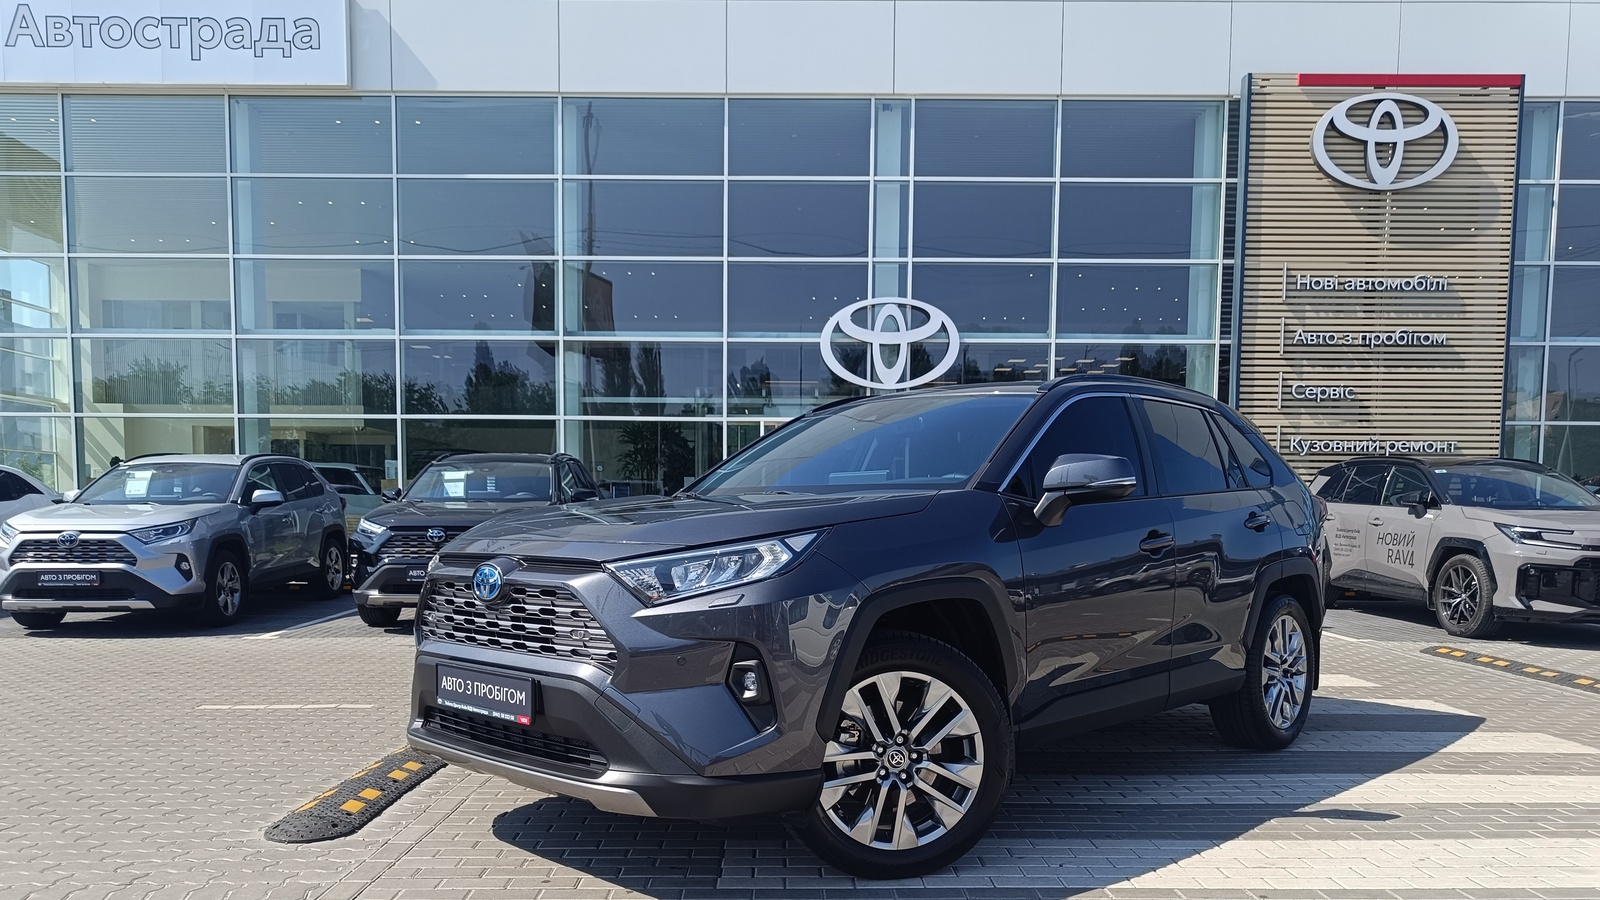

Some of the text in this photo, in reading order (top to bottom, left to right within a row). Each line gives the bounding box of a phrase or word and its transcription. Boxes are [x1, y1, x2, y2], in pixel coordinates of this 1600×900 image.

[5, 3, 321, 61] Автострада
[1296, 274, 1448, 291] Нові автомобілі
[1293, 328, 1447, 349] Авто з пробігом
[1291, 382, 1355, 403] Сервіс
[1289, 435, 1457, 456] Кузовний ремонт
[1376, 530, 1416, 548] НОВИЙ
[1387, 548, 1415, 568] RAV4
[408, 569, 426, 577] АВТО
[441, 675, 526, 706] АВТО З ПРОБІГОМ
